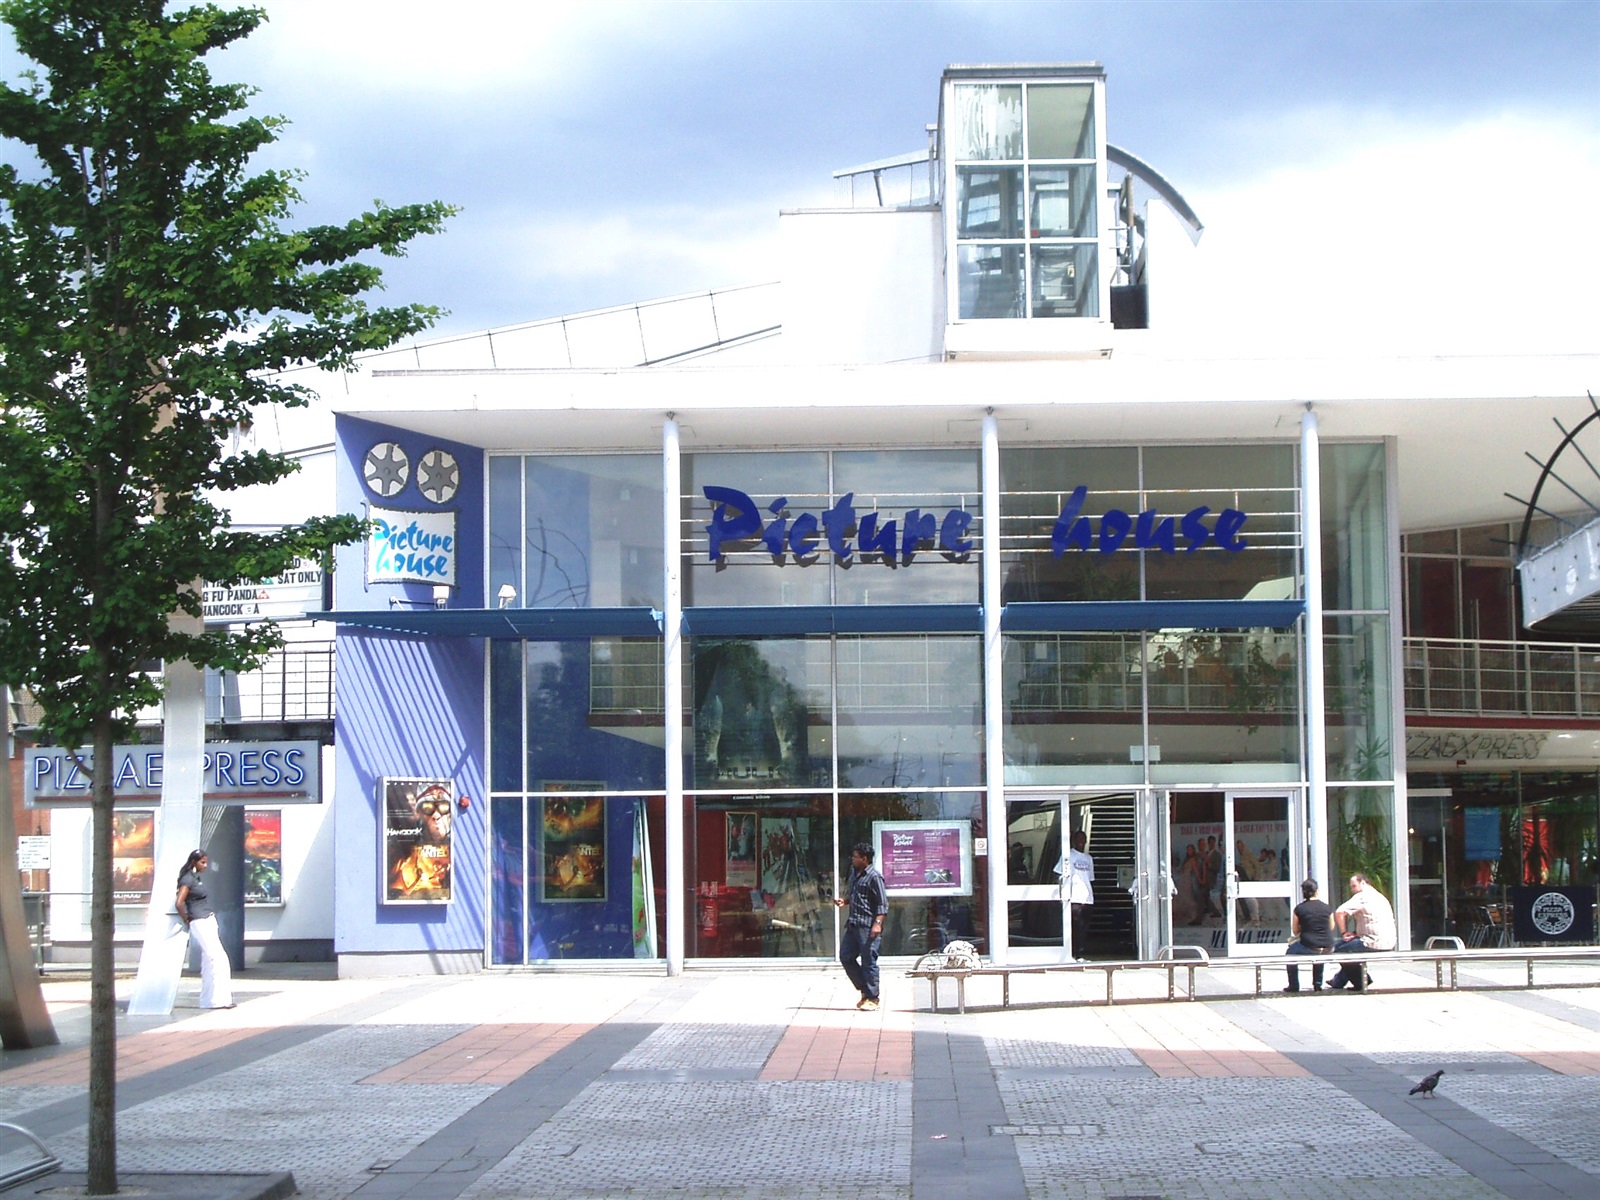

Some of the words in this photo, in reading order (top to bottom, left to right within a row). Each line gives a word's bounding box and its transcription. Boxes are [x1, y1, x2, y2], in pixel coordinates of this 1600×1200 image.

[373, 518, 453, 553] Picture
[702, 485, 973, 561] Picture
[1050, 485, 1248, 559] house
[277, 572, 296, 584] SAT
[298, 571, 322, 583] ONLY
[375, 542, 449, 578] house
[212, 591, 224, 602] FU
[227, 589, 258, 601] PANDA
[34, 749, 305, 791] PIZAEPRESS
